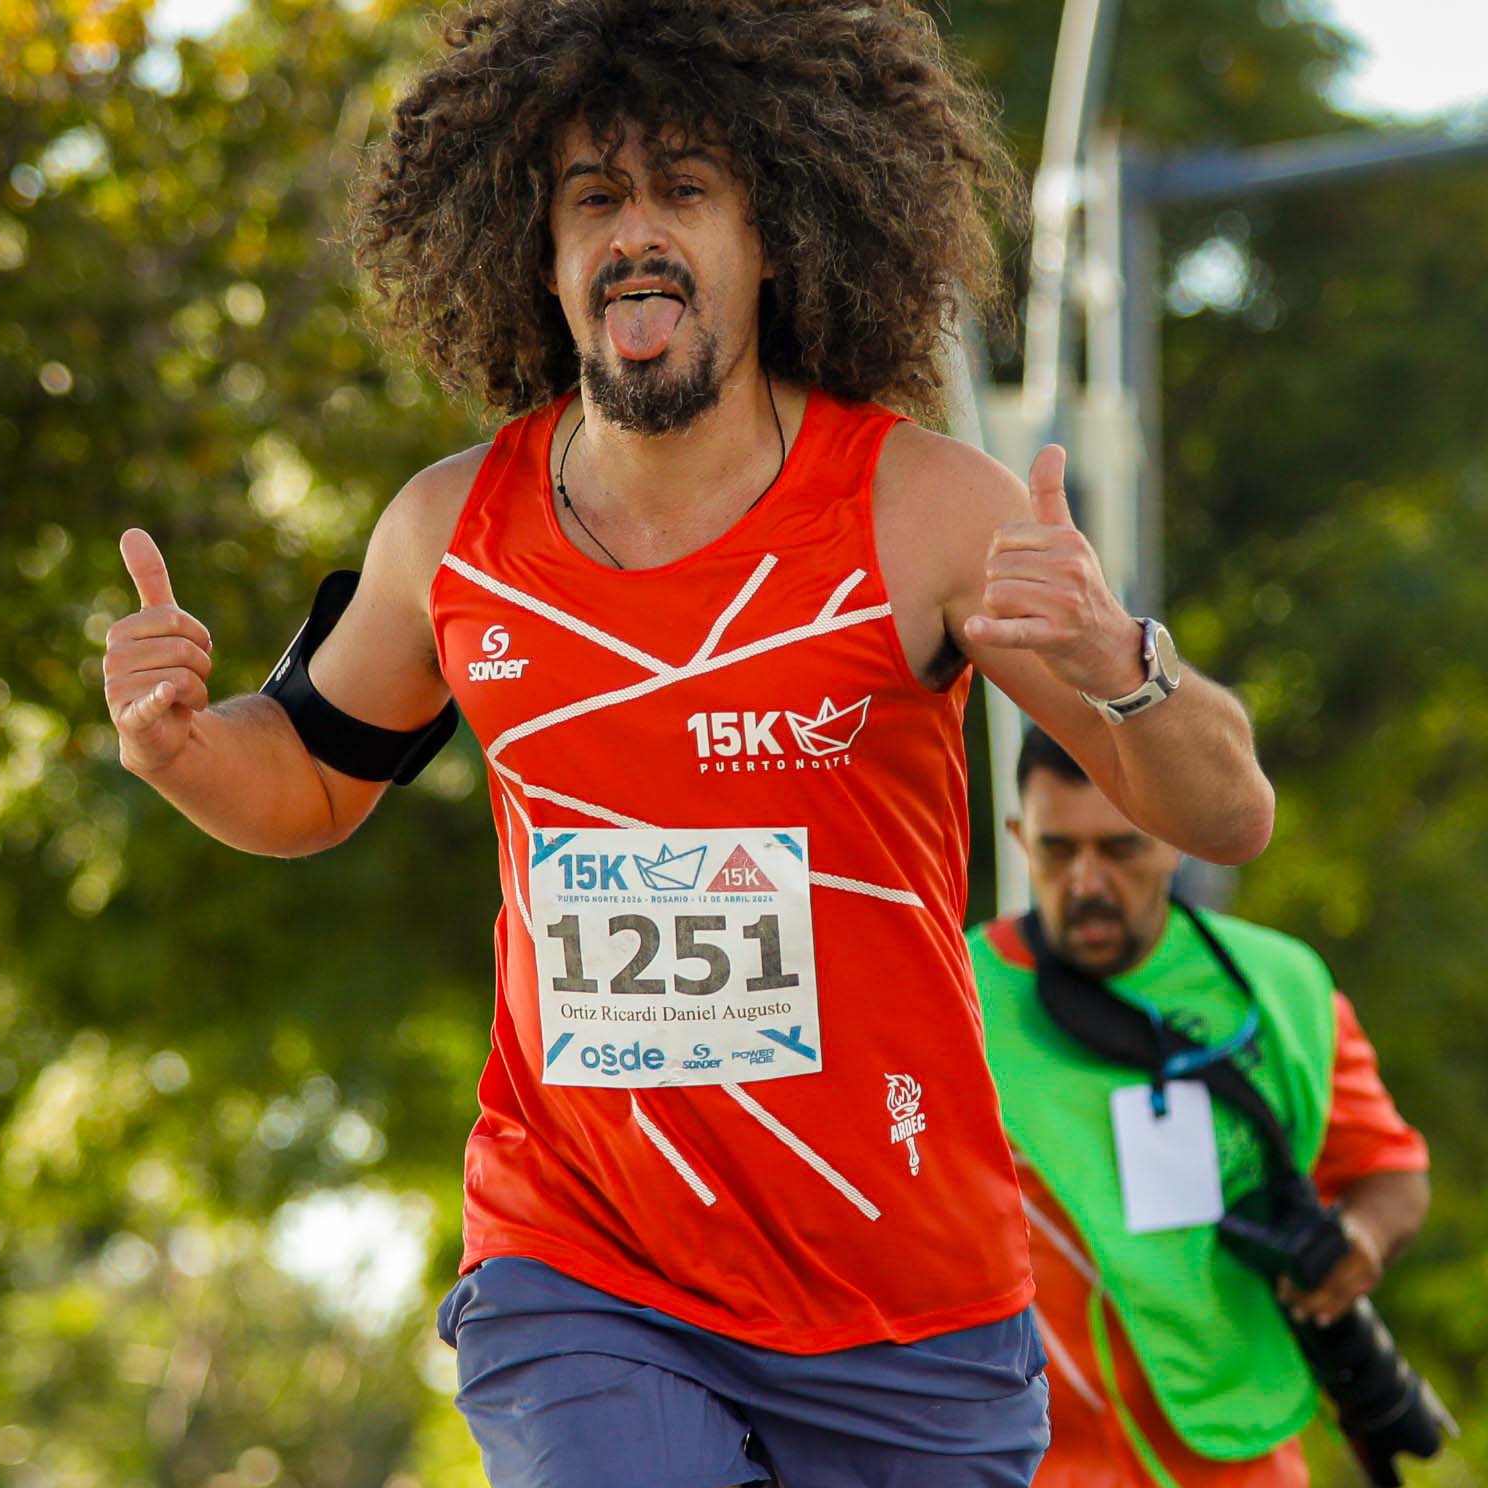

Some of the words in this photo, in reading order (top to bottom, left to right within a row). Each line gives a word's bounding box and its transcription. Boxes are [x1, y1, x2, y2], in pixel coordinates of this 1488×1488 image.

[687, 711, 785, 758] 15K
[700, 760, 786, 774] PUERTO
[558, 853, 629, 891] 15K
[722, 867, 761, 887] 15K
[558, 895, 590, 903] PUERTO
[592, 895, 619, 903] NORTE
[650, 895, 689, 904] ROSARIO
[698, 895, 708, 903] 12
[711, 895, 721, 903] DE
[724, 895, 750, 903] ABRIL
[547, 913, 800, 996] 1251
[561, 1003, 598, 1021] Ortiz
[601, 1005, 657, 1022] Ricardi
[663, 1005, 716, 1022] Daniel
[723, 1002, 792, 1022] Augusto
[580, 1041, 665, 1075] osde
[890, 1113, 926, 1144] ARDEC
